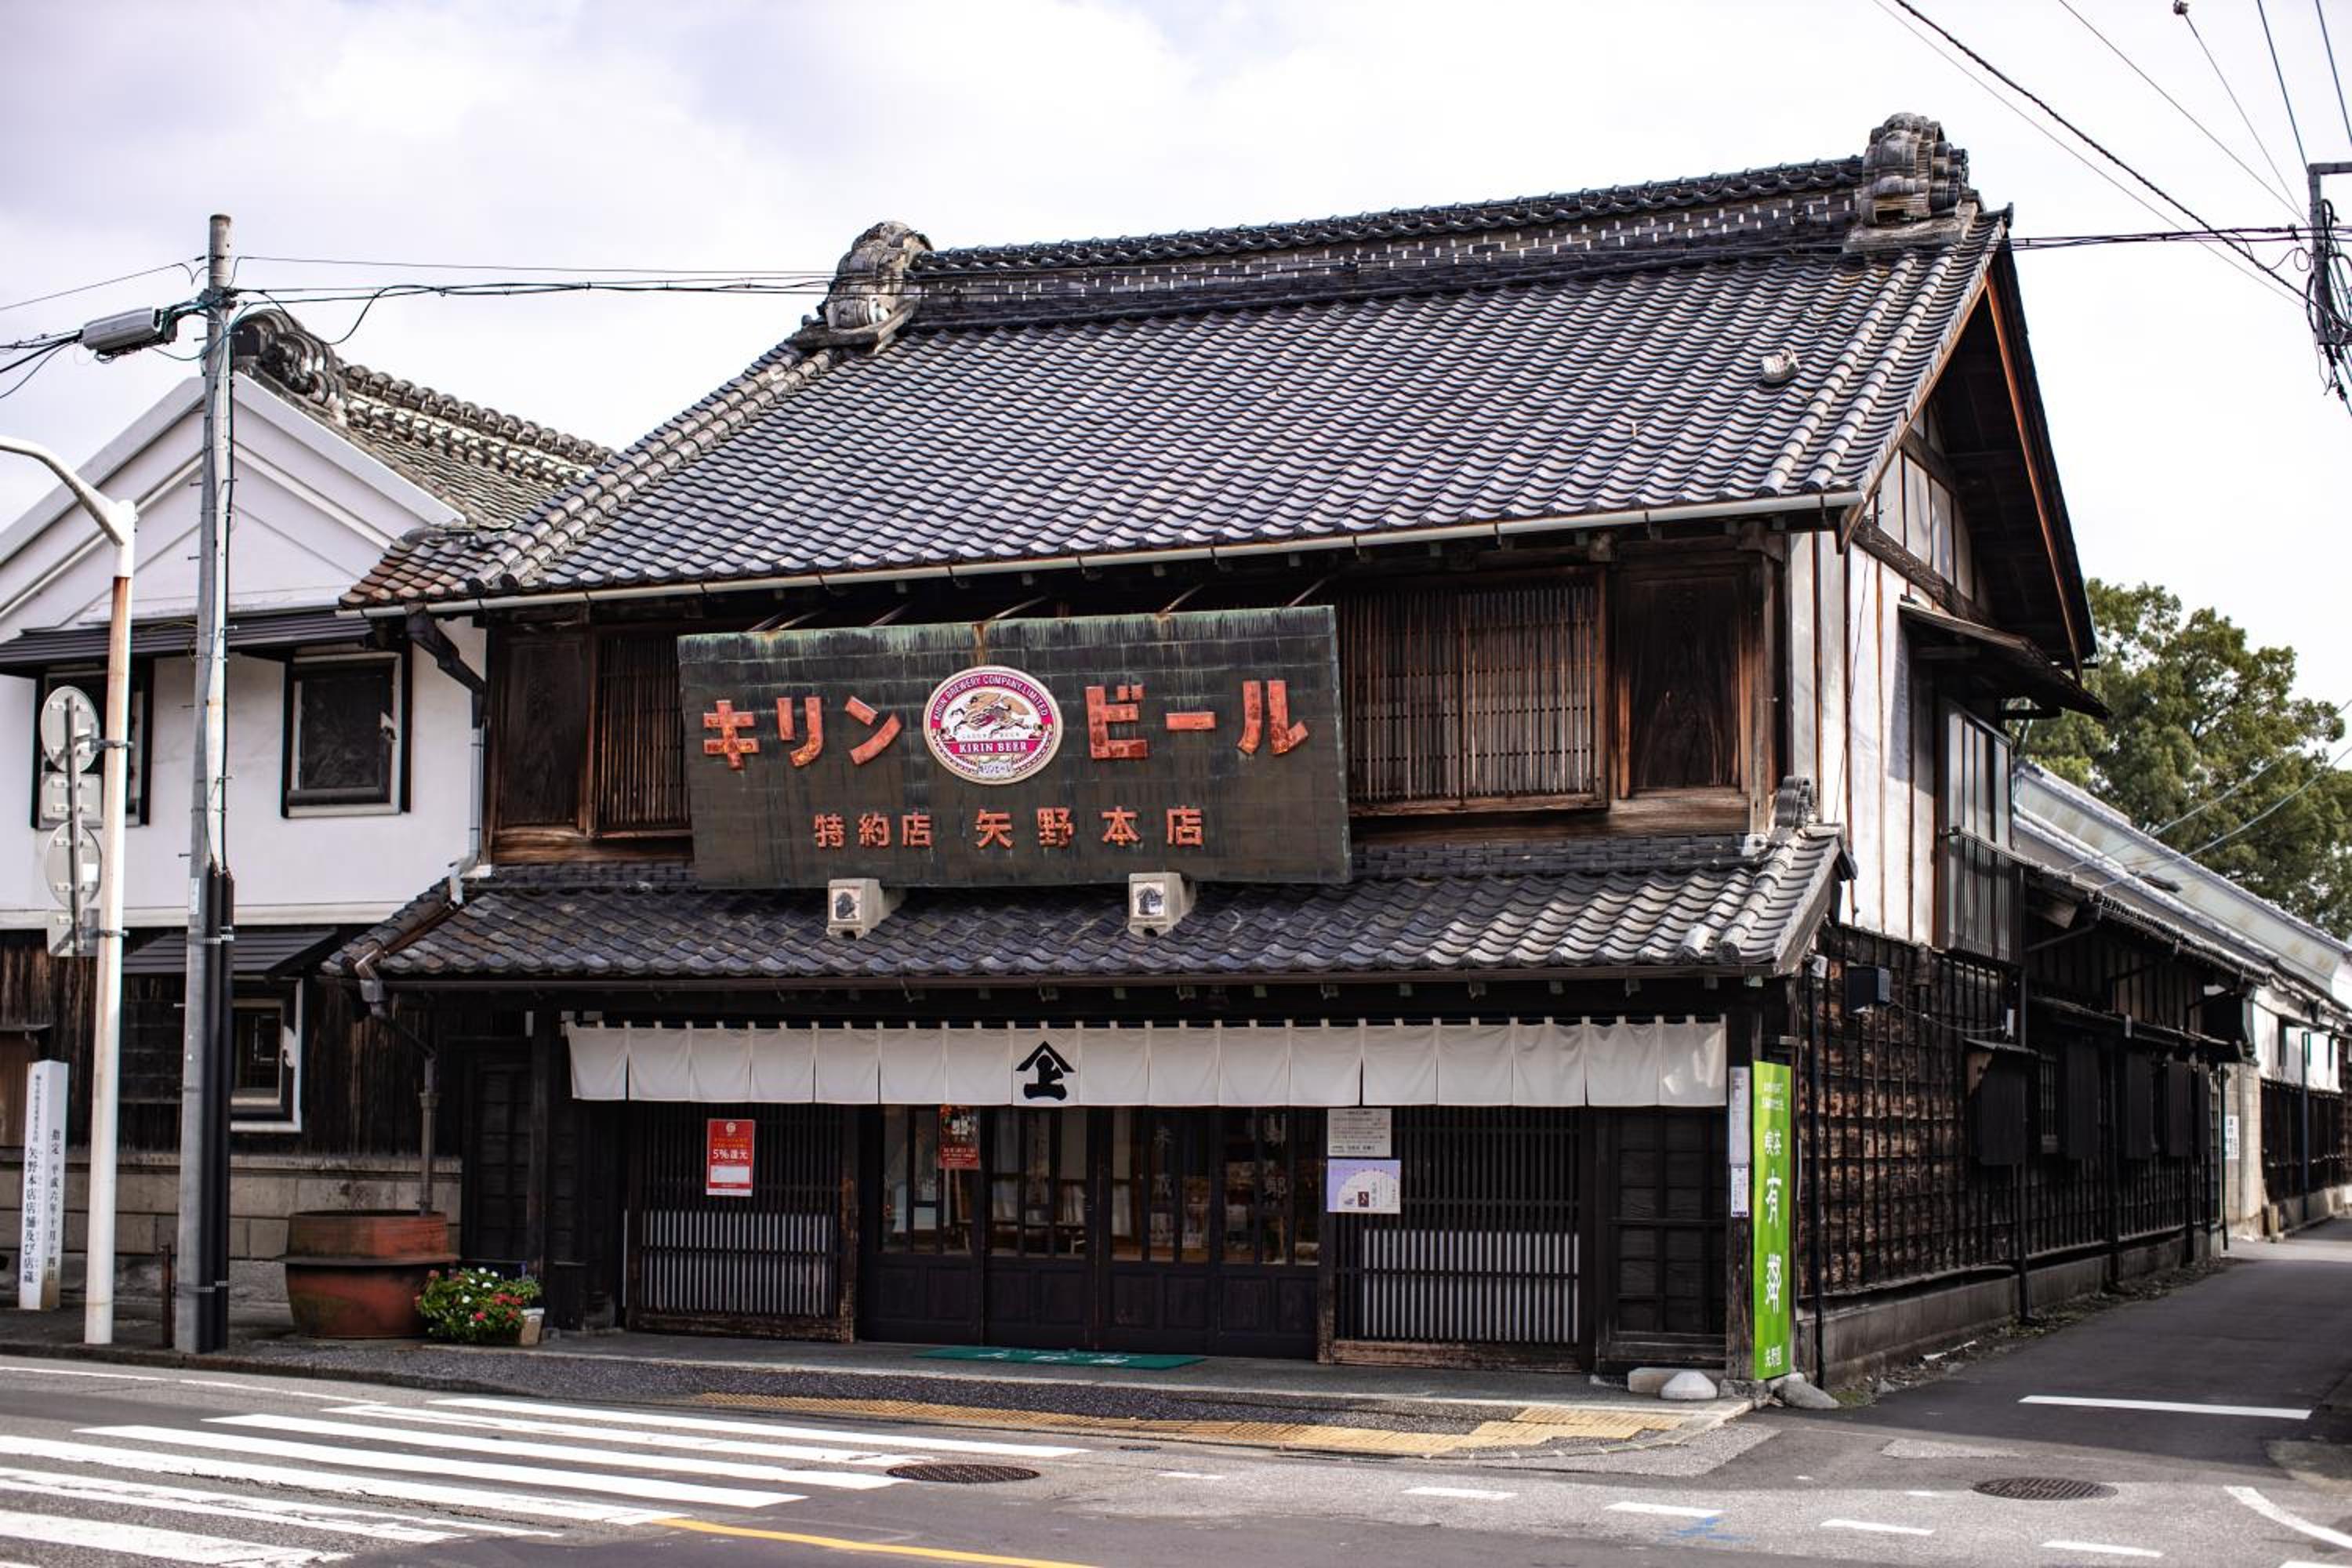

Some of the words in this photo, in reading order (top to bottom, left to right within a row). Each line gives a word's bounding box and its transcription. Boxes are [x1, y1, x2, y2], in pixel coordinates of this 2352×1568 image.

[703, 695, 902, 769] キリン
[1085, 680, 1308, 759] ビール
[958, 742, 993, 753] KIRIN
[998, 741, 1027, 753] BEER
[814, 811, 933, 848] 特約店
[975, 805, 1205, 848] 矢野本店
